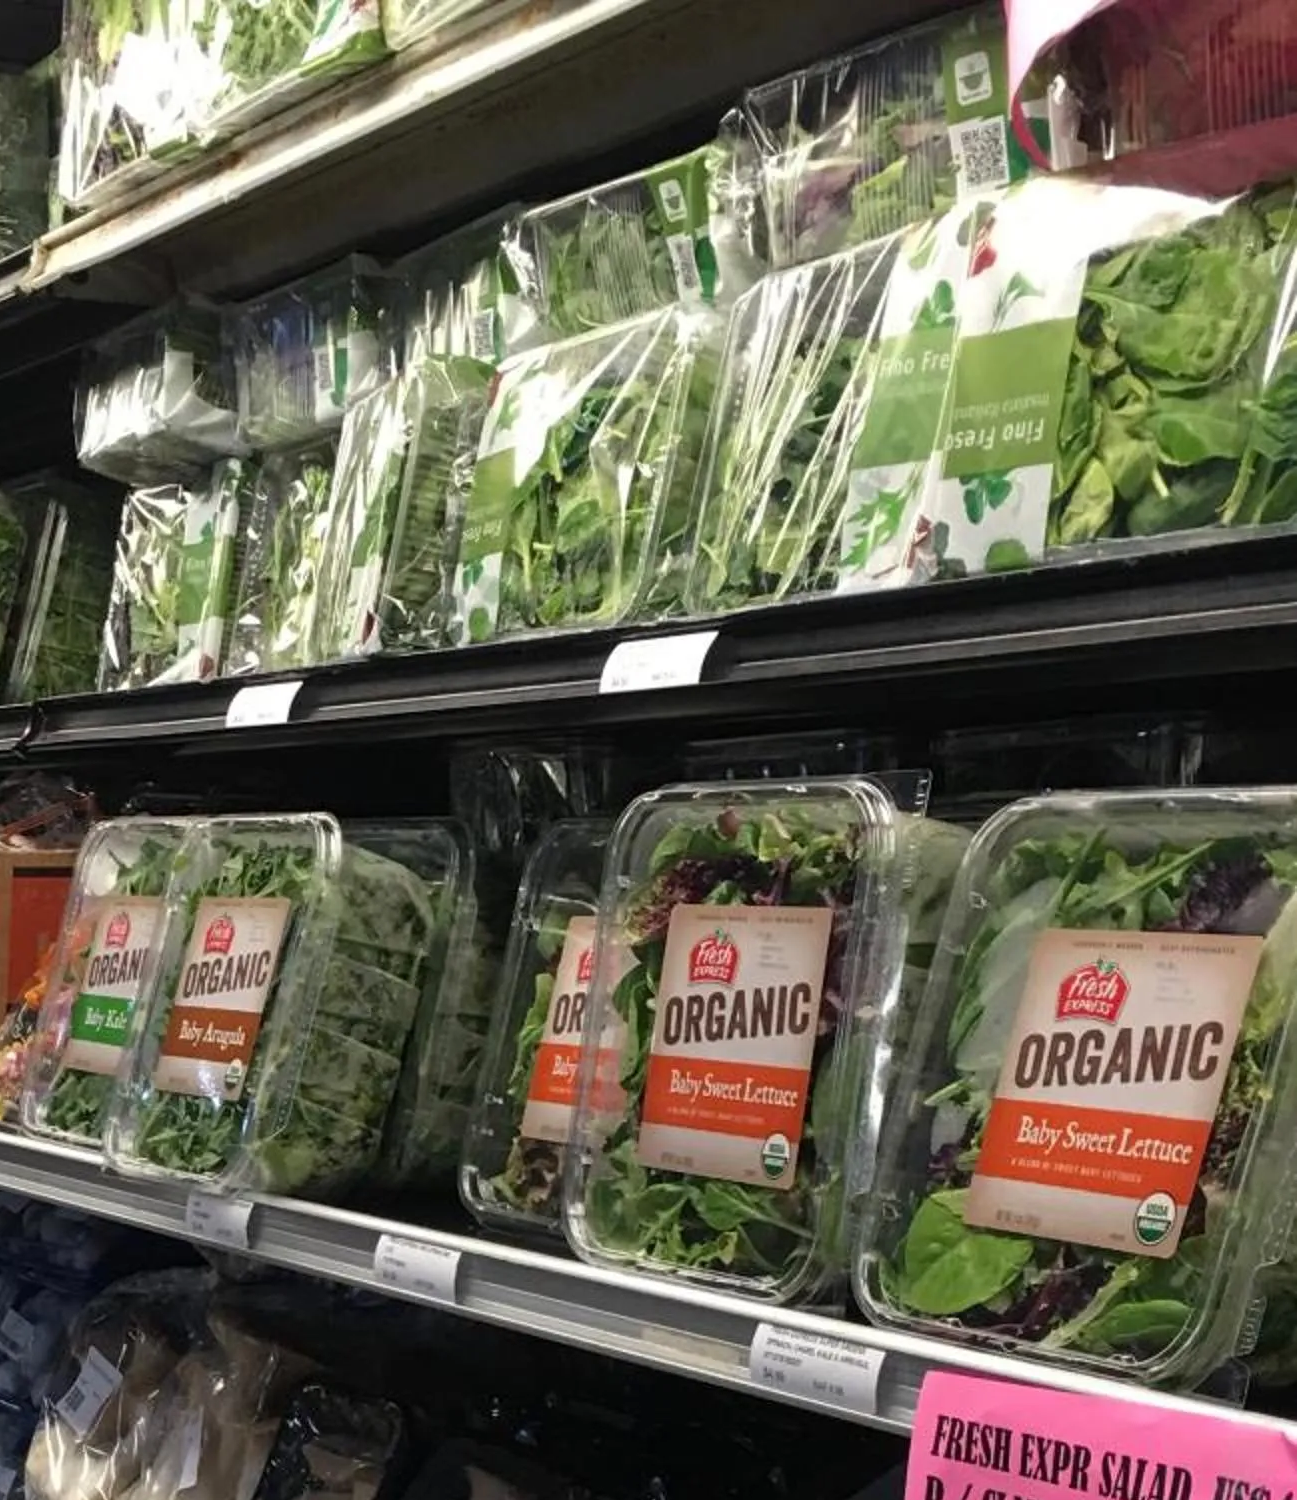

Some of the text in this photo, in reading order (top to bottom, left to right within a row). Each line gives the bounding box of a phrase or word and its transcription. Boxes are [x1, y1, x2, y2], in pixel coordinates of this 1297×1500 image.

[921, 350, 951, 371] Fre
[1002, 417, 1045, 444] Fino
[88, 946, 150, 988] ORGANI
[696, 932, 734, 967] Fresh
[182, 949, 271, 998] ORGANIC
[1067, 969, 1120, 1000] Fresh
[663, 981, 811, 1047] ORGANIC
[1063, 999, 1115, 1016] EXPRESS
[178, 1019, 247, 1050] Baby Arugula
[1014, 1020, 1224, 1088] ORGANIC
[669, 1068, 799, 1108] Baby Sweet Lettuce
[1016, 1115, 1194, 1165] Baby Sweet Lettuce
[930, 1414, 1013, 1473] FRESH
[1019, 1432, 1093, 1492] EXPR
